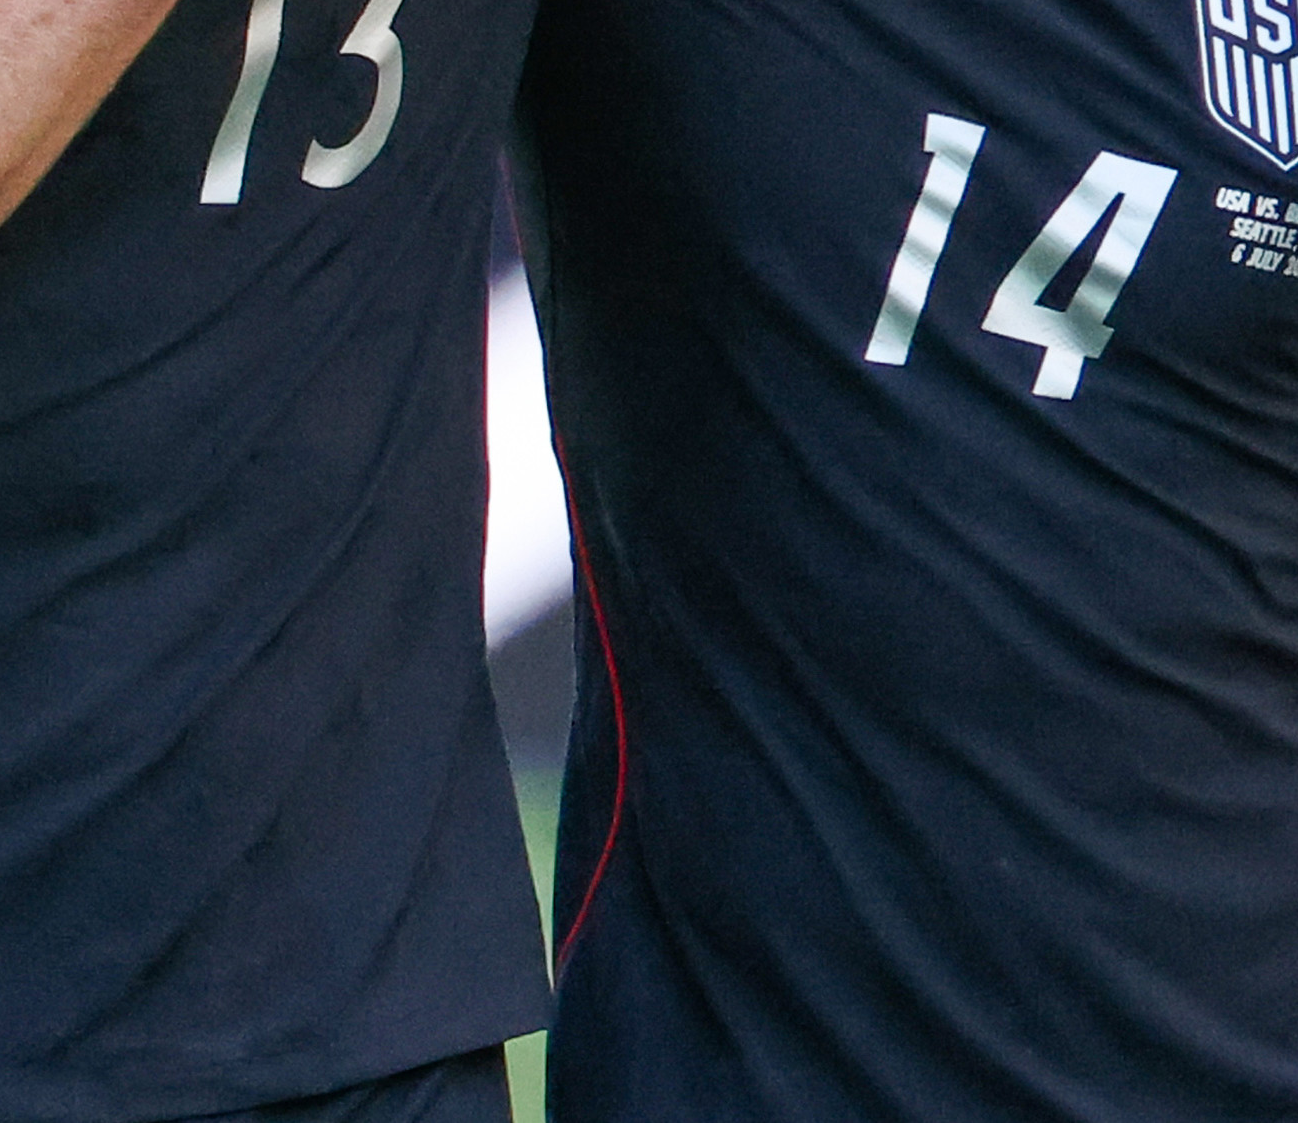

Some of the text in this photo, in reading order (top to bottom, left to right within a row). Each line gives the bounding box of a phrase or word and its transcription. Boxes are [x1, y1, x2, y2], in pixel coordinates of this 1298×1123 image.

[1215, 186, 1251, 213] USA
[1255, 195, 1280, 220] VS.
[1229, 216, 1298, 253] SEATTLE,
[863, 112, 1179, 401] 14
[1231, 243, 1246, 264] 6
[1245, 246, 1285, 272] JULY
